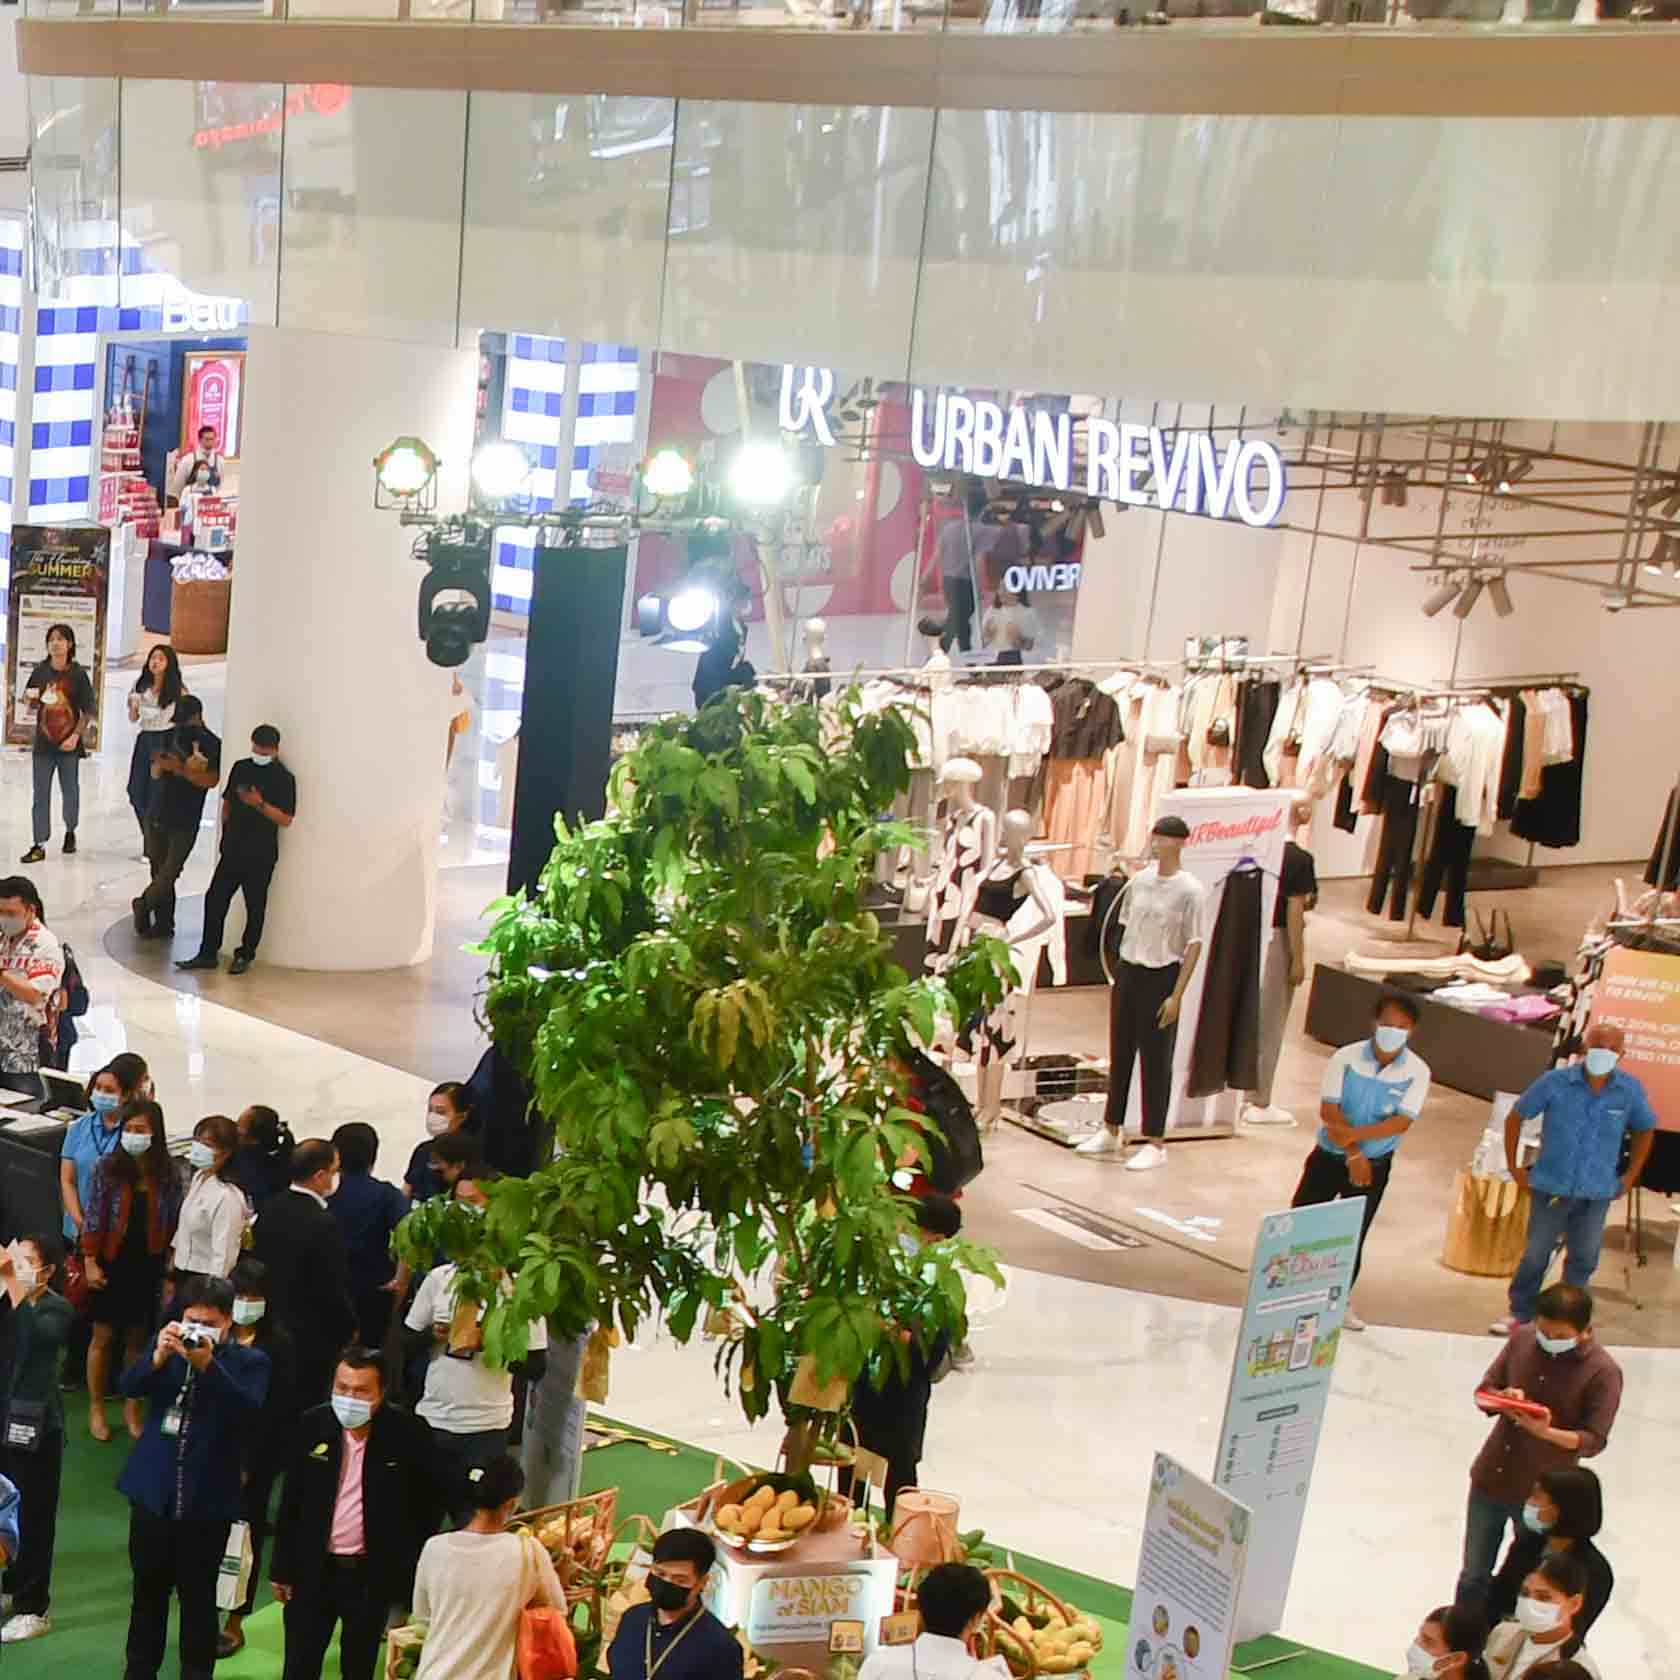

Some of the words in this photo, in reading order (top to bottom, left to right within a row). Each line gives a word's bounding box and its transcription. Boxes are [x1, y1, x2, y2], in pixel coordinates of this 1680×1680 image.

[910, 391, 1075, 491] URBAN
[1086, 416, 1288, 528] REVIVO
[768, 1575, 865, 1601] MANGO
[798, 1595, 849, 1618] SIAM
